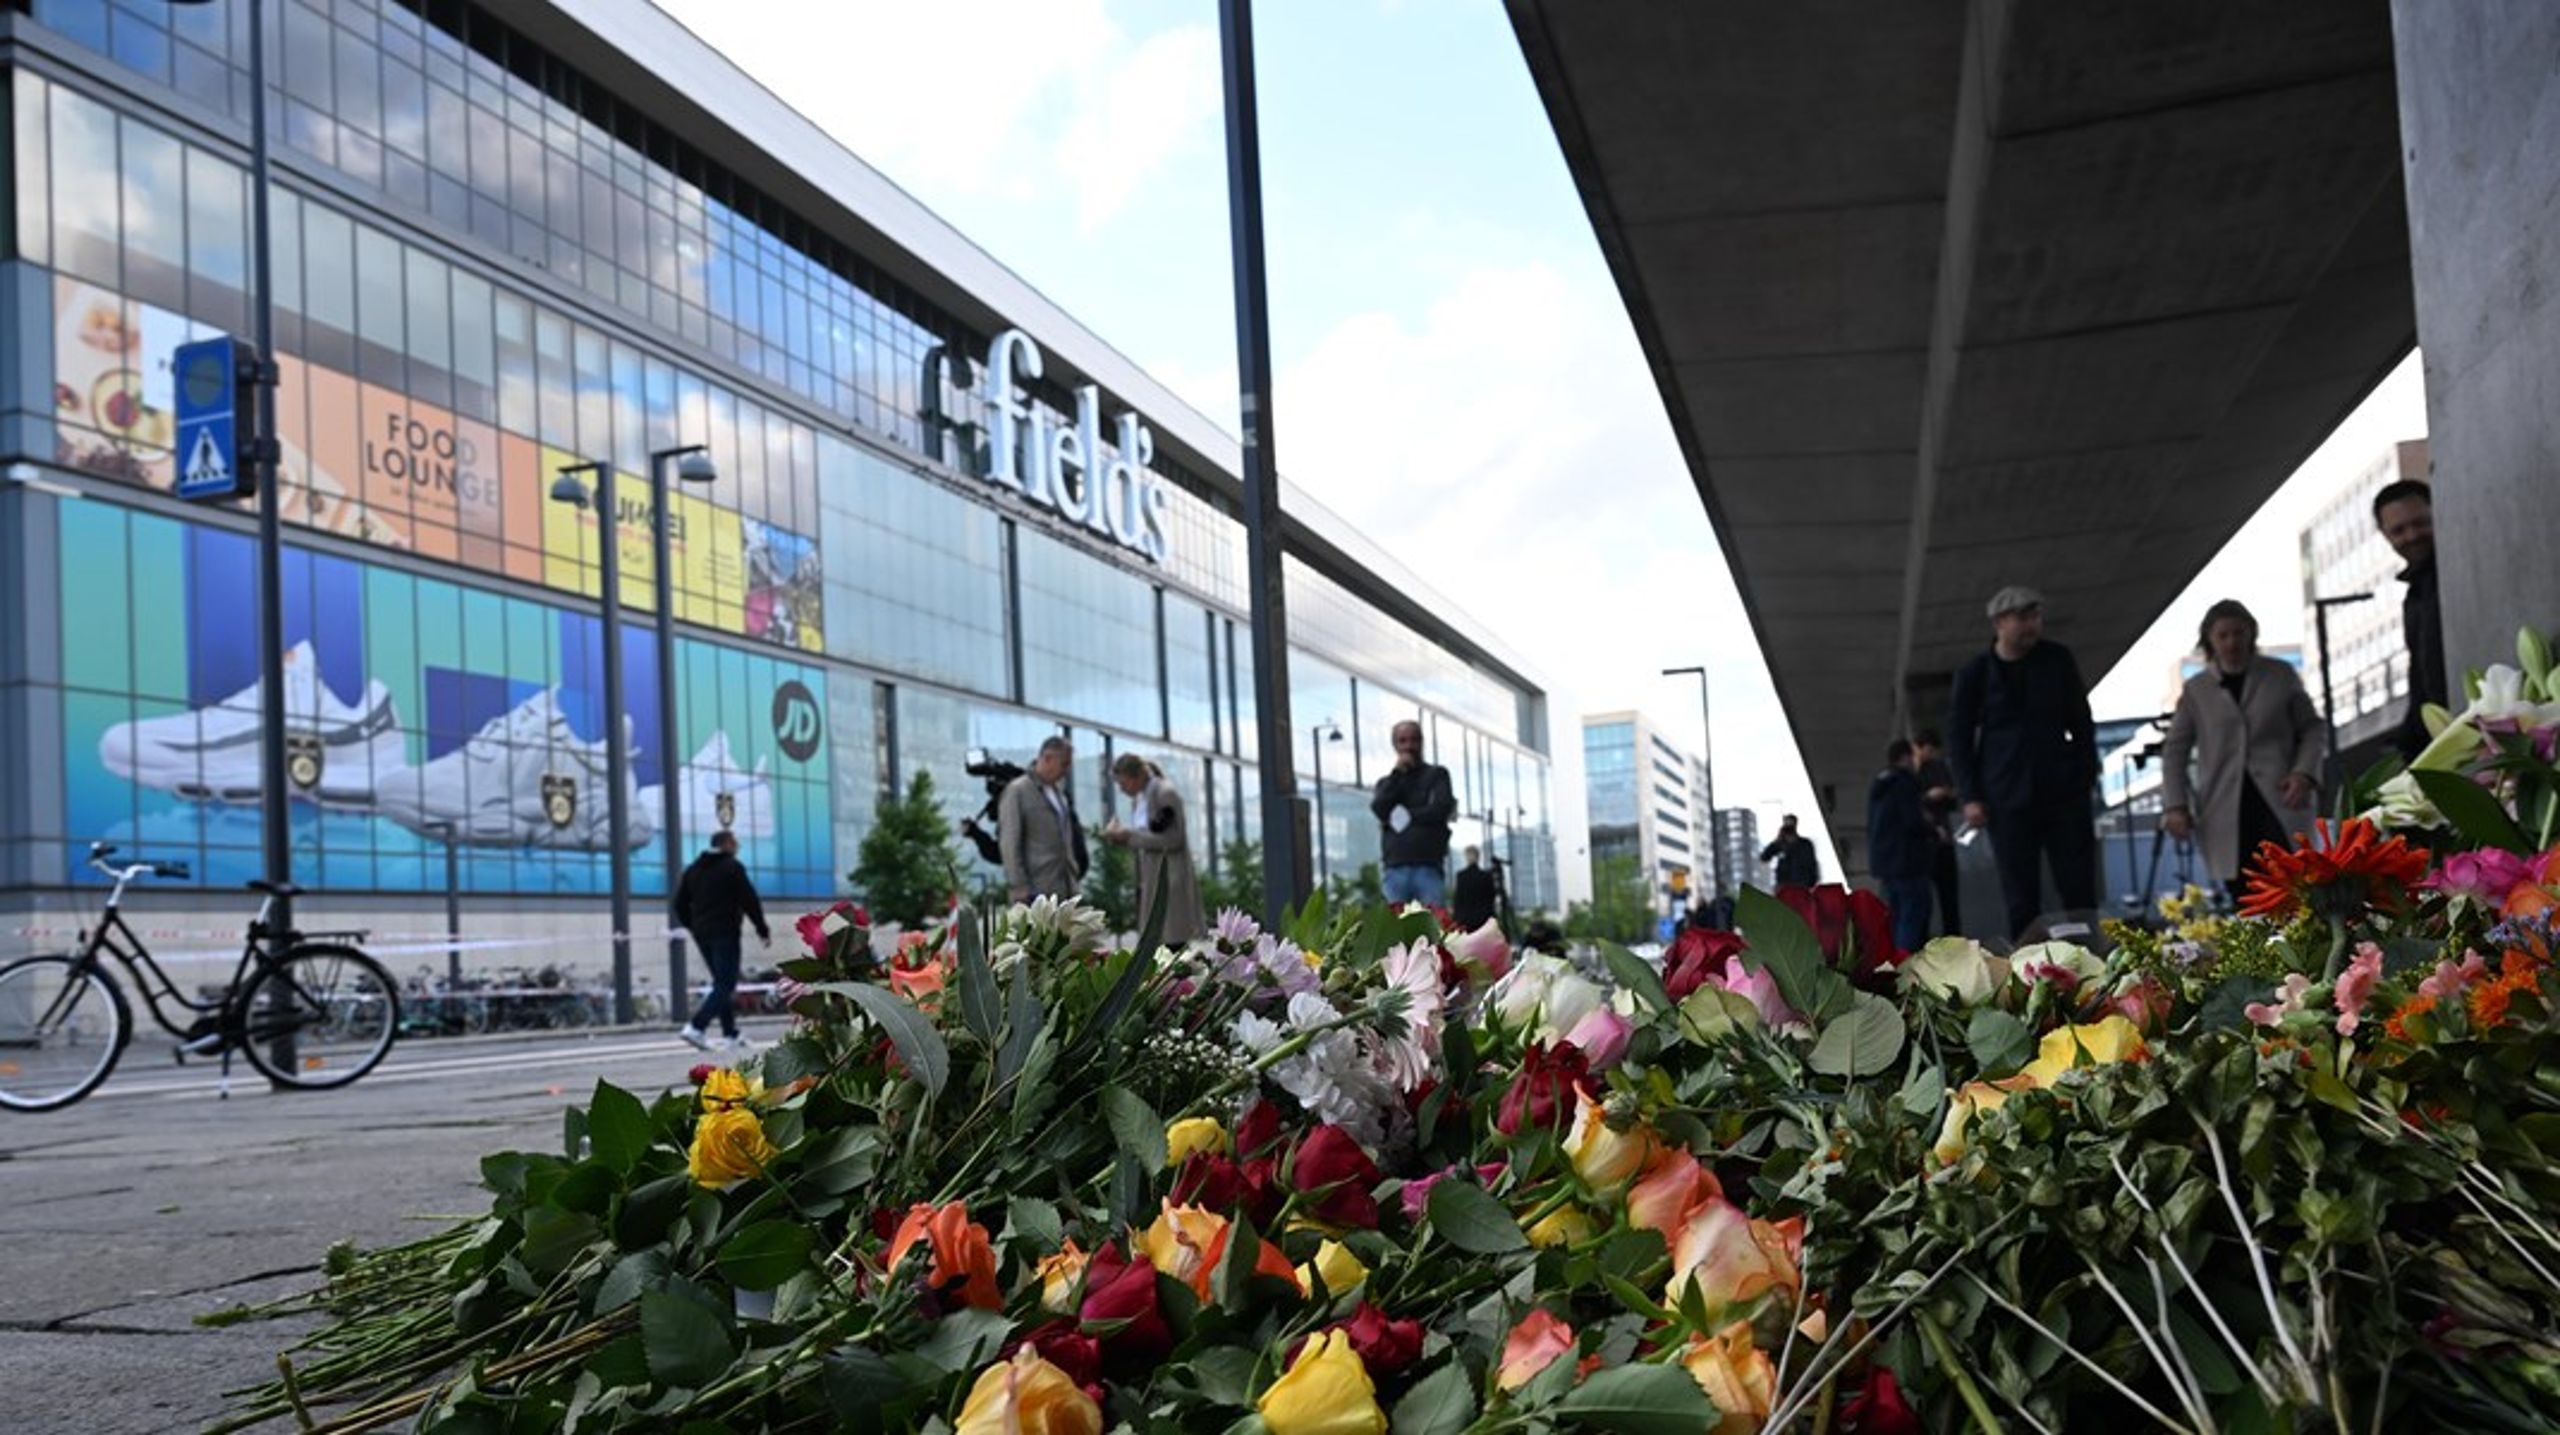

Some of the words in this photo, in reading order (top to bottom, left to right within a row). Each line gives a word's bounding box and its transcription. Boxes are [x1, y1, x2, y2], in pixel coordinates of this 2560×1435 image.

[387, 413, 477, 466] FOOD
[985, 328, 1171, 563] field's
[366, 440, 498, 507] LOUNGE
[779, 698, 816, 742] JD
